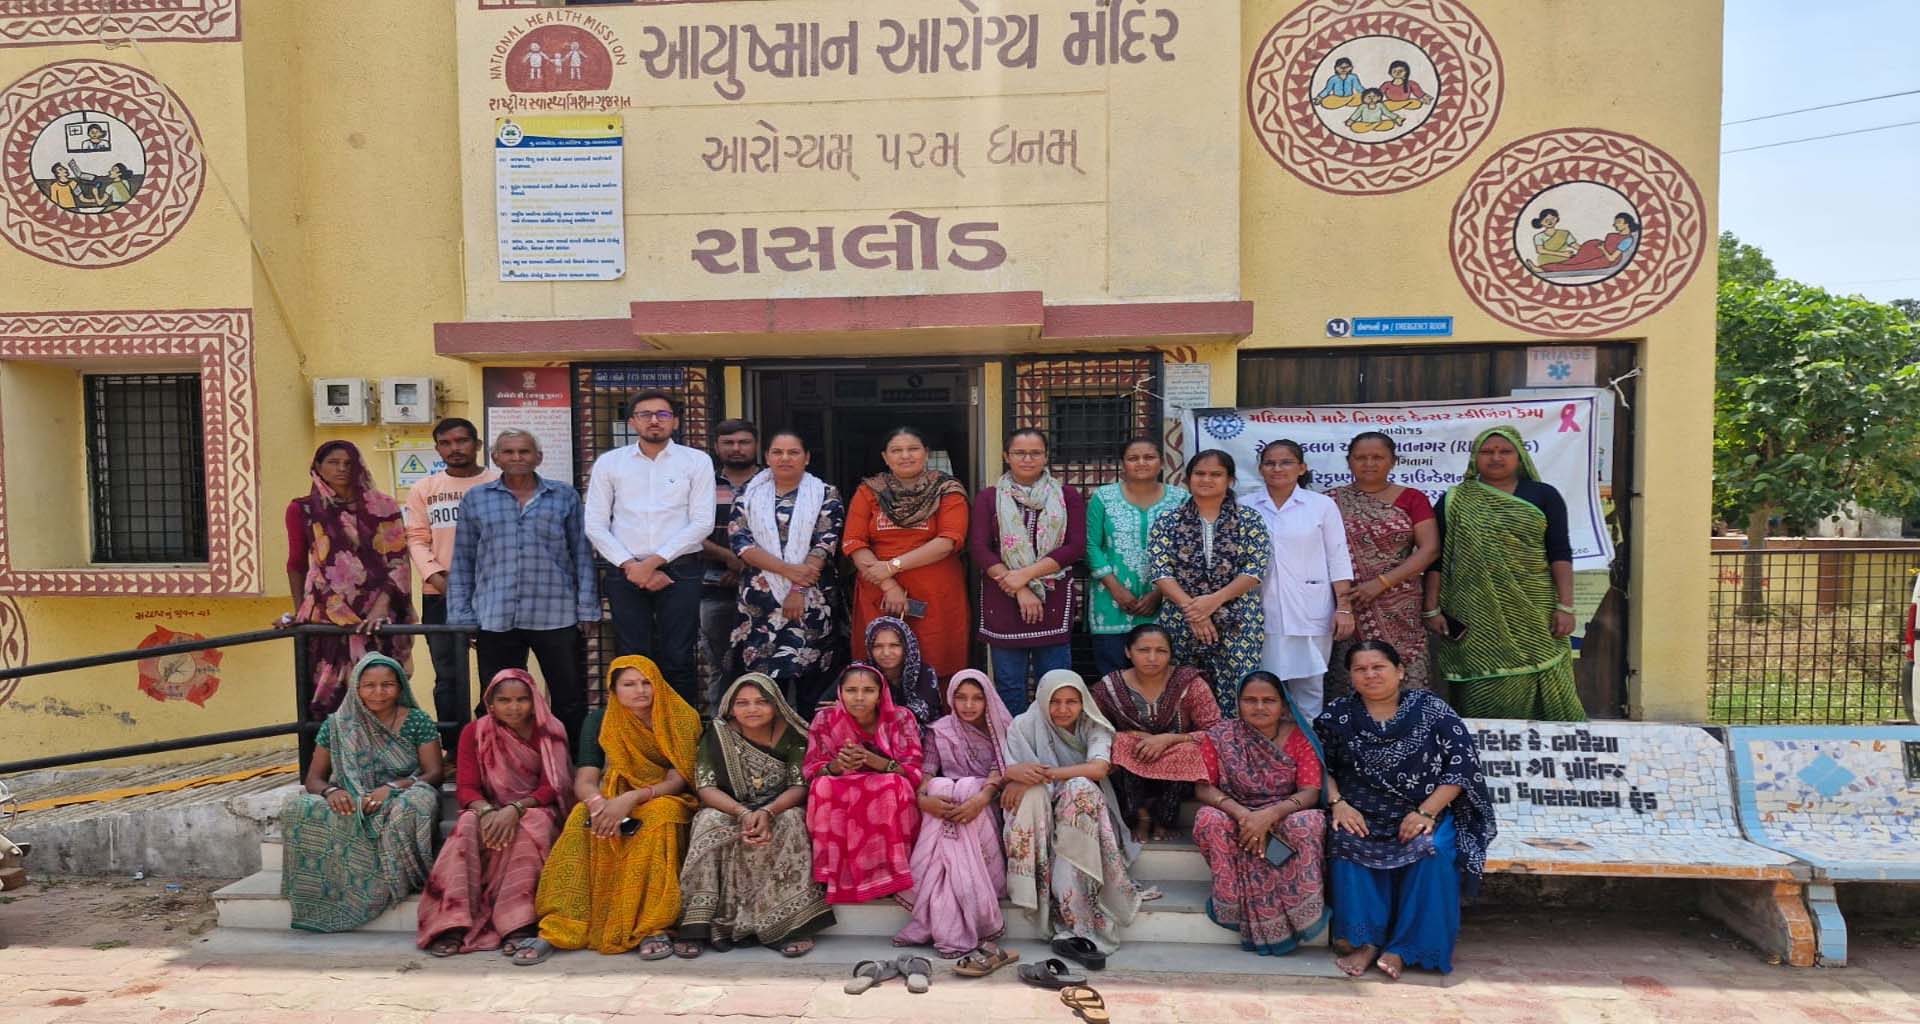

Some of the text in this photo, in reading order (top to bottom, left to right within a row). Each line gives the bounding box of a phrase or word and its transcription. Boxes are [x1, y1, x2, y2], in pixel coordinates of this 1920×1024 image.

[490, 9, 627, 80] NATIONAL HEALTH MISSION
[639, 0, 1180, 101] આયુષ્માન આરોગ્ય મંદિર
[691, 210, 1008, 274] રાસલોડ
[1530, 350, 1592, 361] TRIAGE
[1320, 411, 1348, 424] માટે
